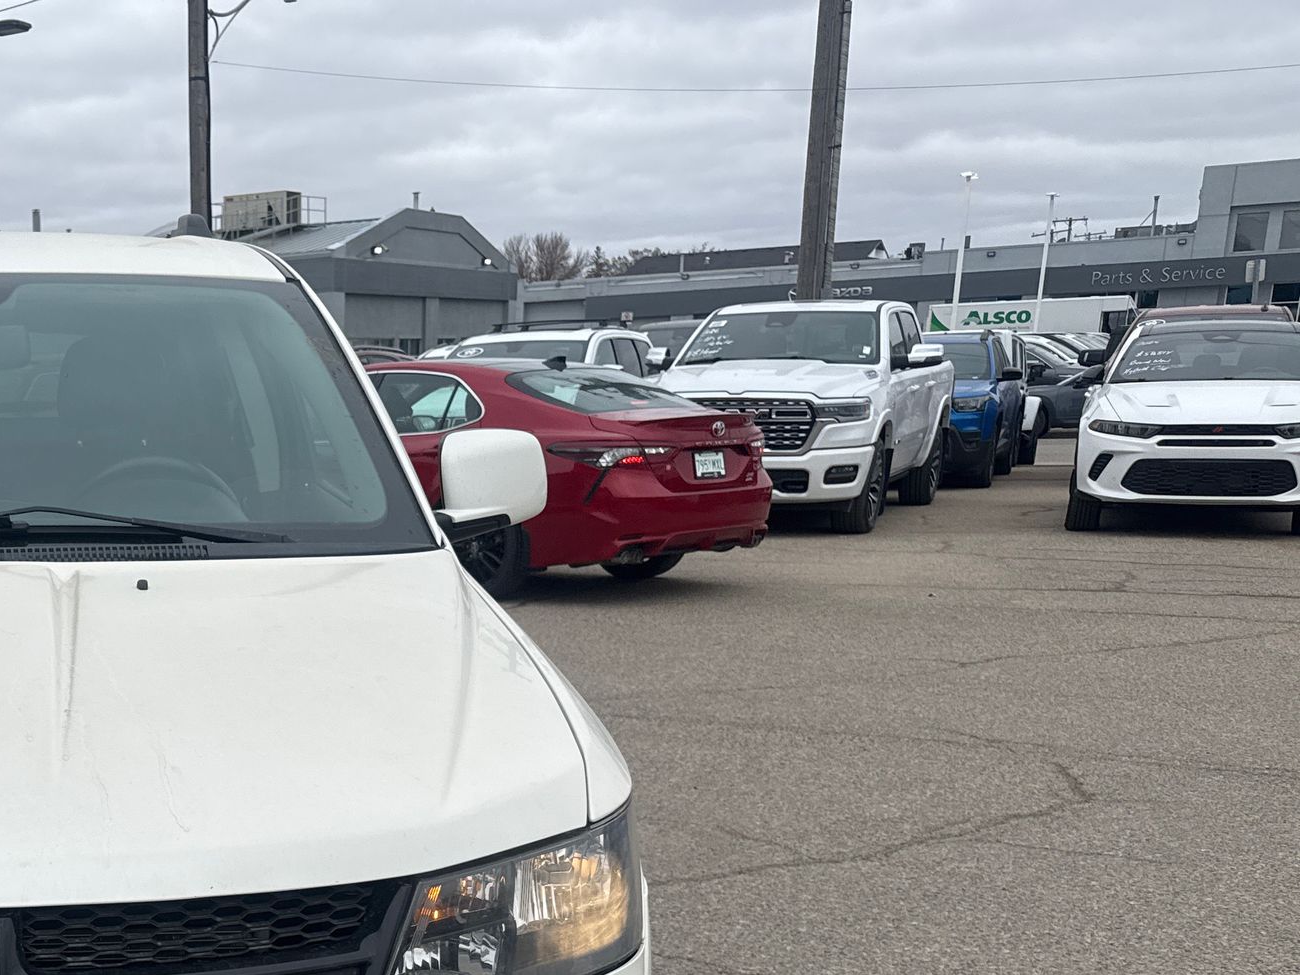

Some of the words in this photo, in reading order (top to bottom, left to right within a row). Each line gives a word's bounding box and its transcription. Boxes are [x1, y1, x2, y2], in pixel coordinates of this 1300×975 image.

[1091, 271, 1133, 286] Parts
[1140, 268, 1153, 284] &
[1160, 265, 1226, 283] Service
